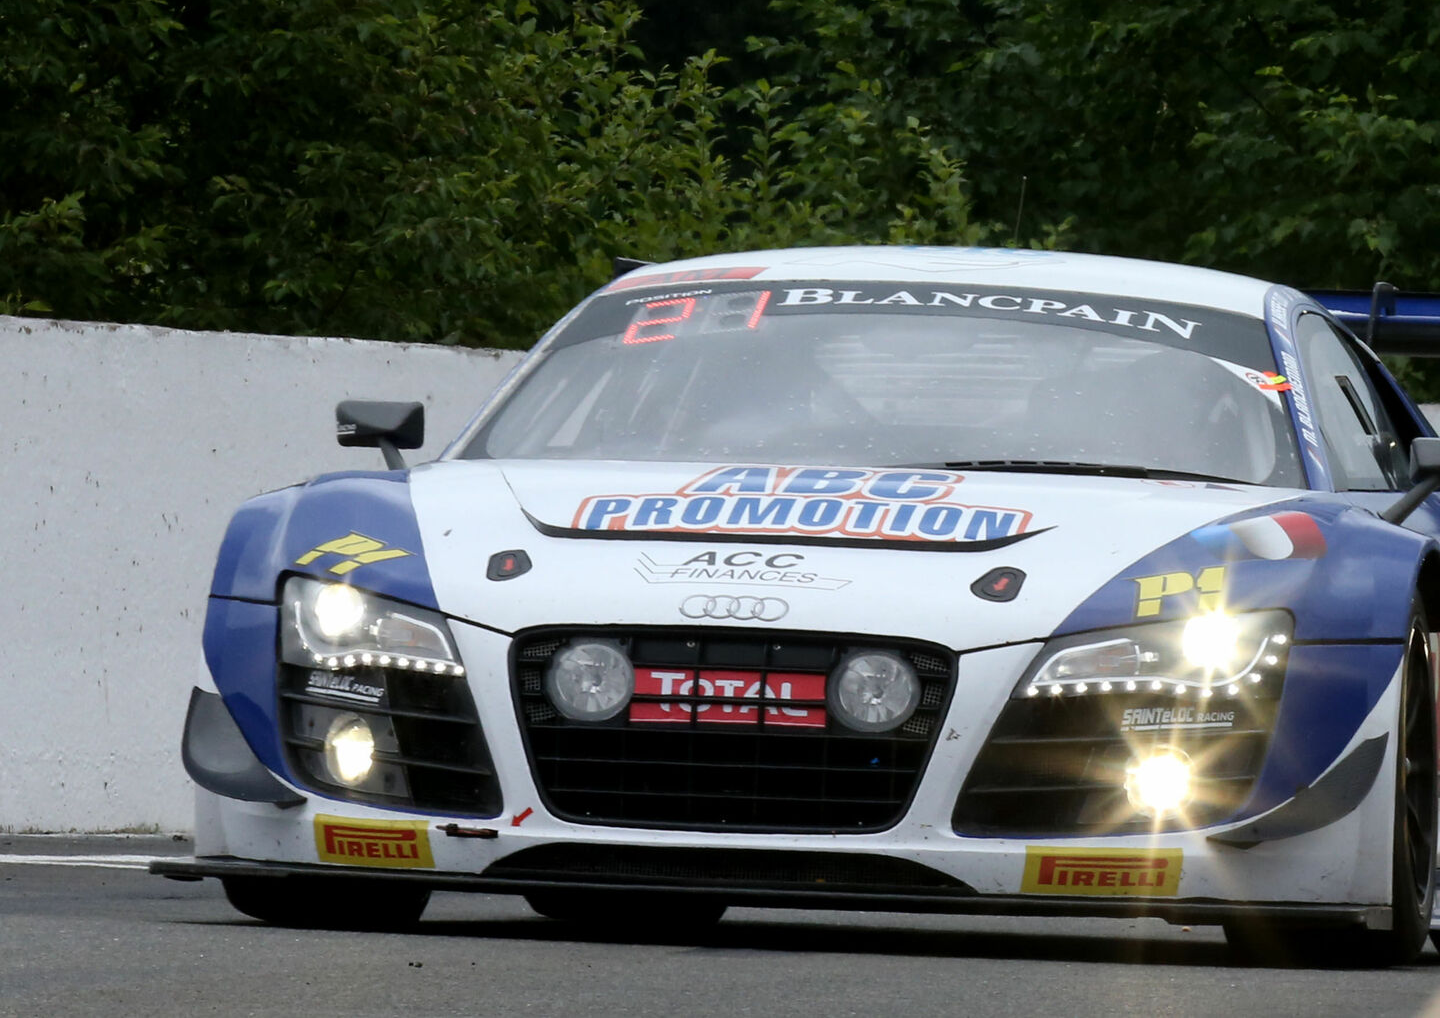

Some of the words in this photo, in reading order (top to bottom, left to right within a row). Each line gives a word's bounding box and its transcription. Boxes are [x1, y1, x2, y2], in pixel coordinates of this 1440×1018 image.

[625, 289, 713, 305] POSITION
[777, 287, 1202, 340] BLANCPAIN
[690, 466, 956, 501] ABC
[584, 494, 1020, 542] PROMOTION
[669, 567, 819, 584] FINANCES
[682, 550, 805, 569] ACC
[1134, 566, 1226, 618] P1
[650, 671, 809, 717] TOTAL
[1196, 711, 1236, 723] RACING
[323, 824, 420, 860] PIRELLI
[1037, 855, 1169, 887] PIRELLI
